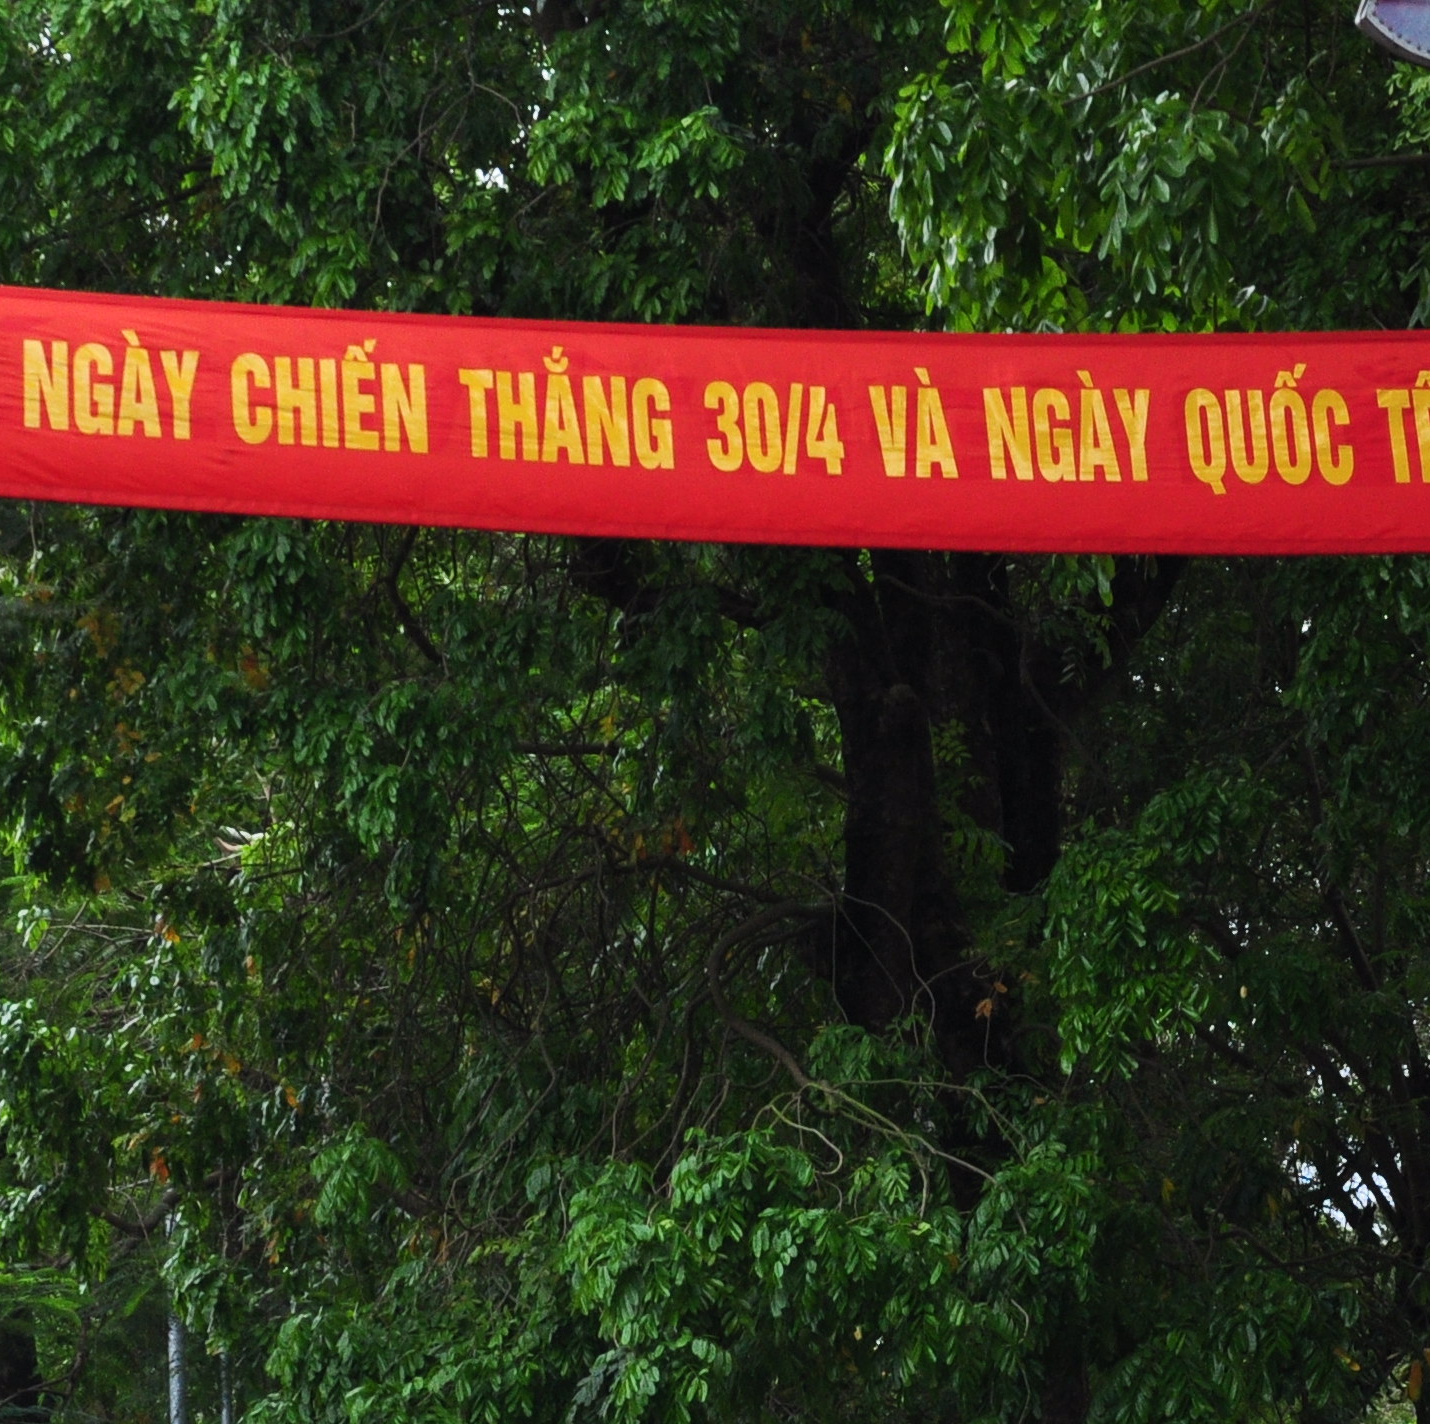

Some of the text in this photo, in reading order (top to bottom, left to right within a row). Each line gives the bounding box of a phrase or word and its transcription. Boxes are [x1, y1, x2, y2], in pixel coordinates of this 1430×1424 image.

[23, 329, 199, 439] NGÀY
[231, 339, 428, 453] CHIẾN
[459, 346, 674, 469] THẮNG
[704, 381, 844, 474] 30/4
[869, 368, 958, 478] VÀ
[983, 371, 1149, 482] NGÀY
[1185, 364, 1353, 494] QUỐC
